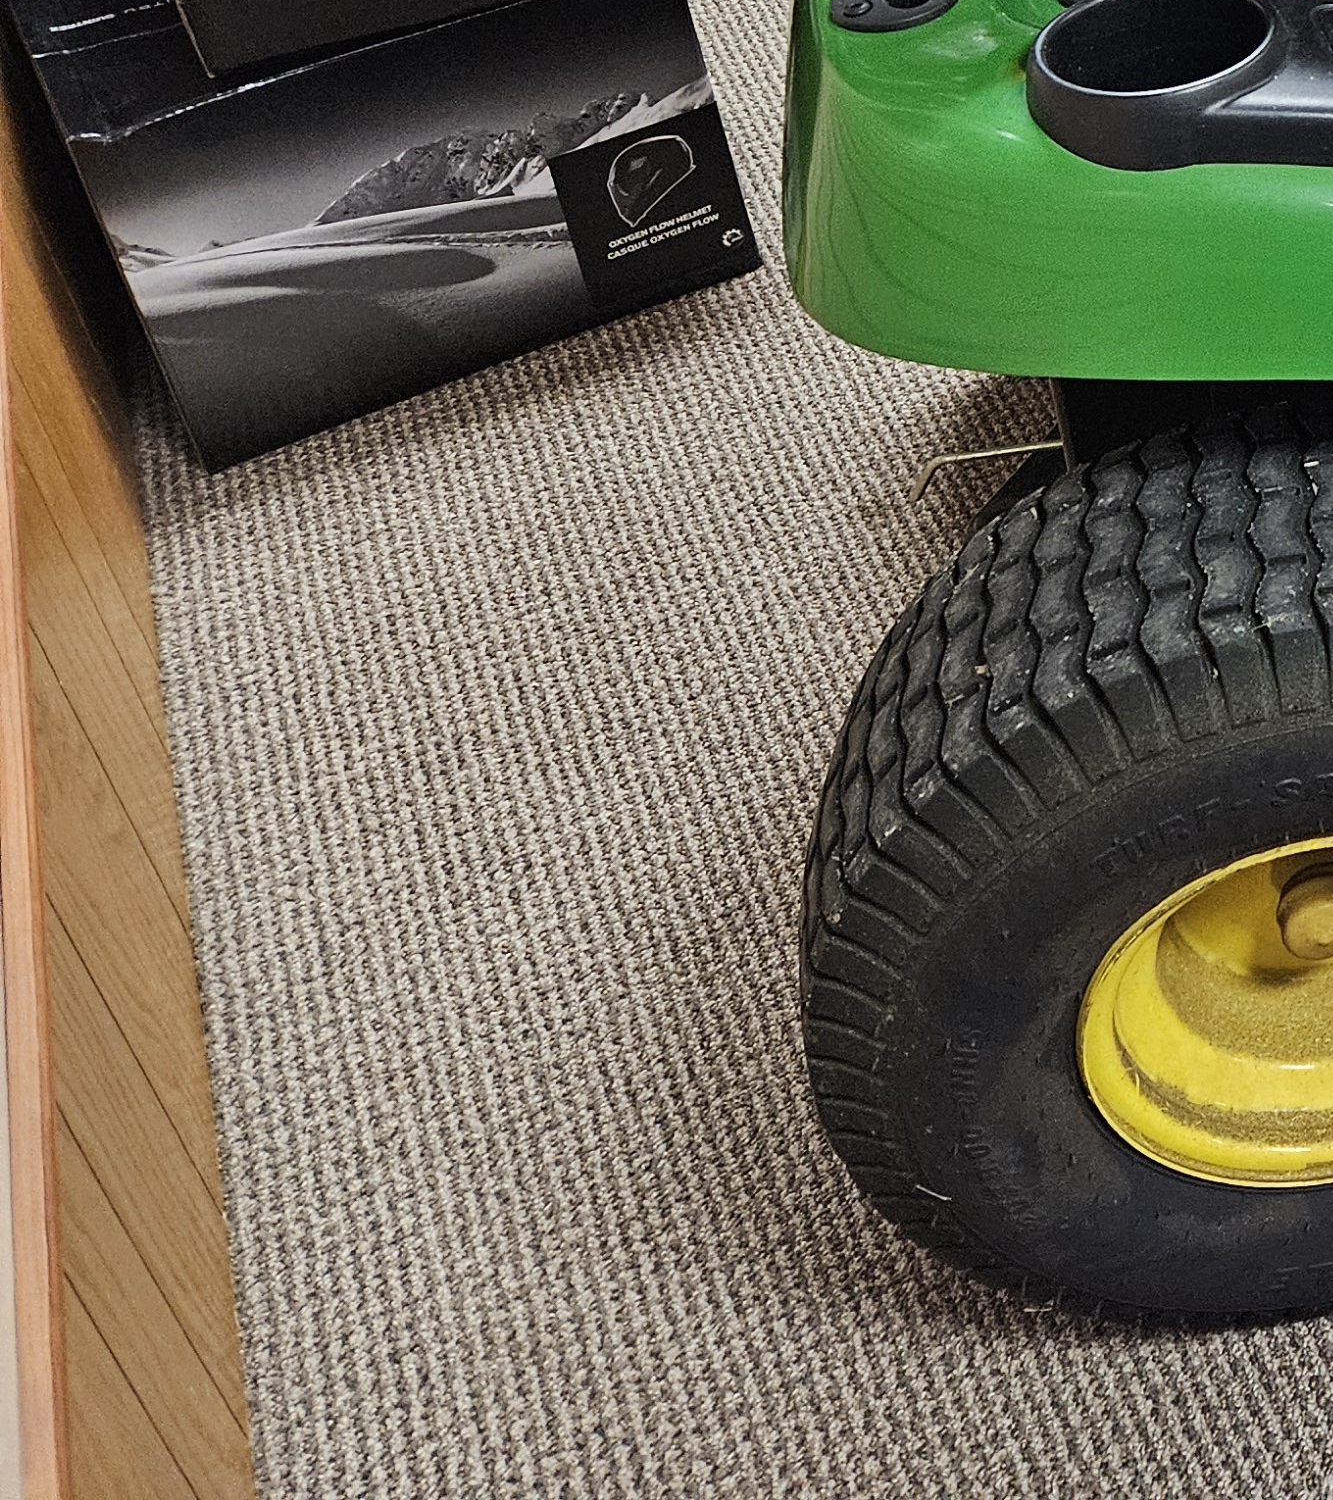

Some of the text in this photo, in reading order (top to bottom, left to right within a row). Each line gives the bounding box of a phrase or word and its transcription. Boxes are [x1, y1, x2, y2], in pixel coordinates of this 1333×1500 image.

[607, 213, 719, 259] CASQUE OXYGEN FLOW
[609, 205, 712, 248] OXYGEN FLOW HELMET
